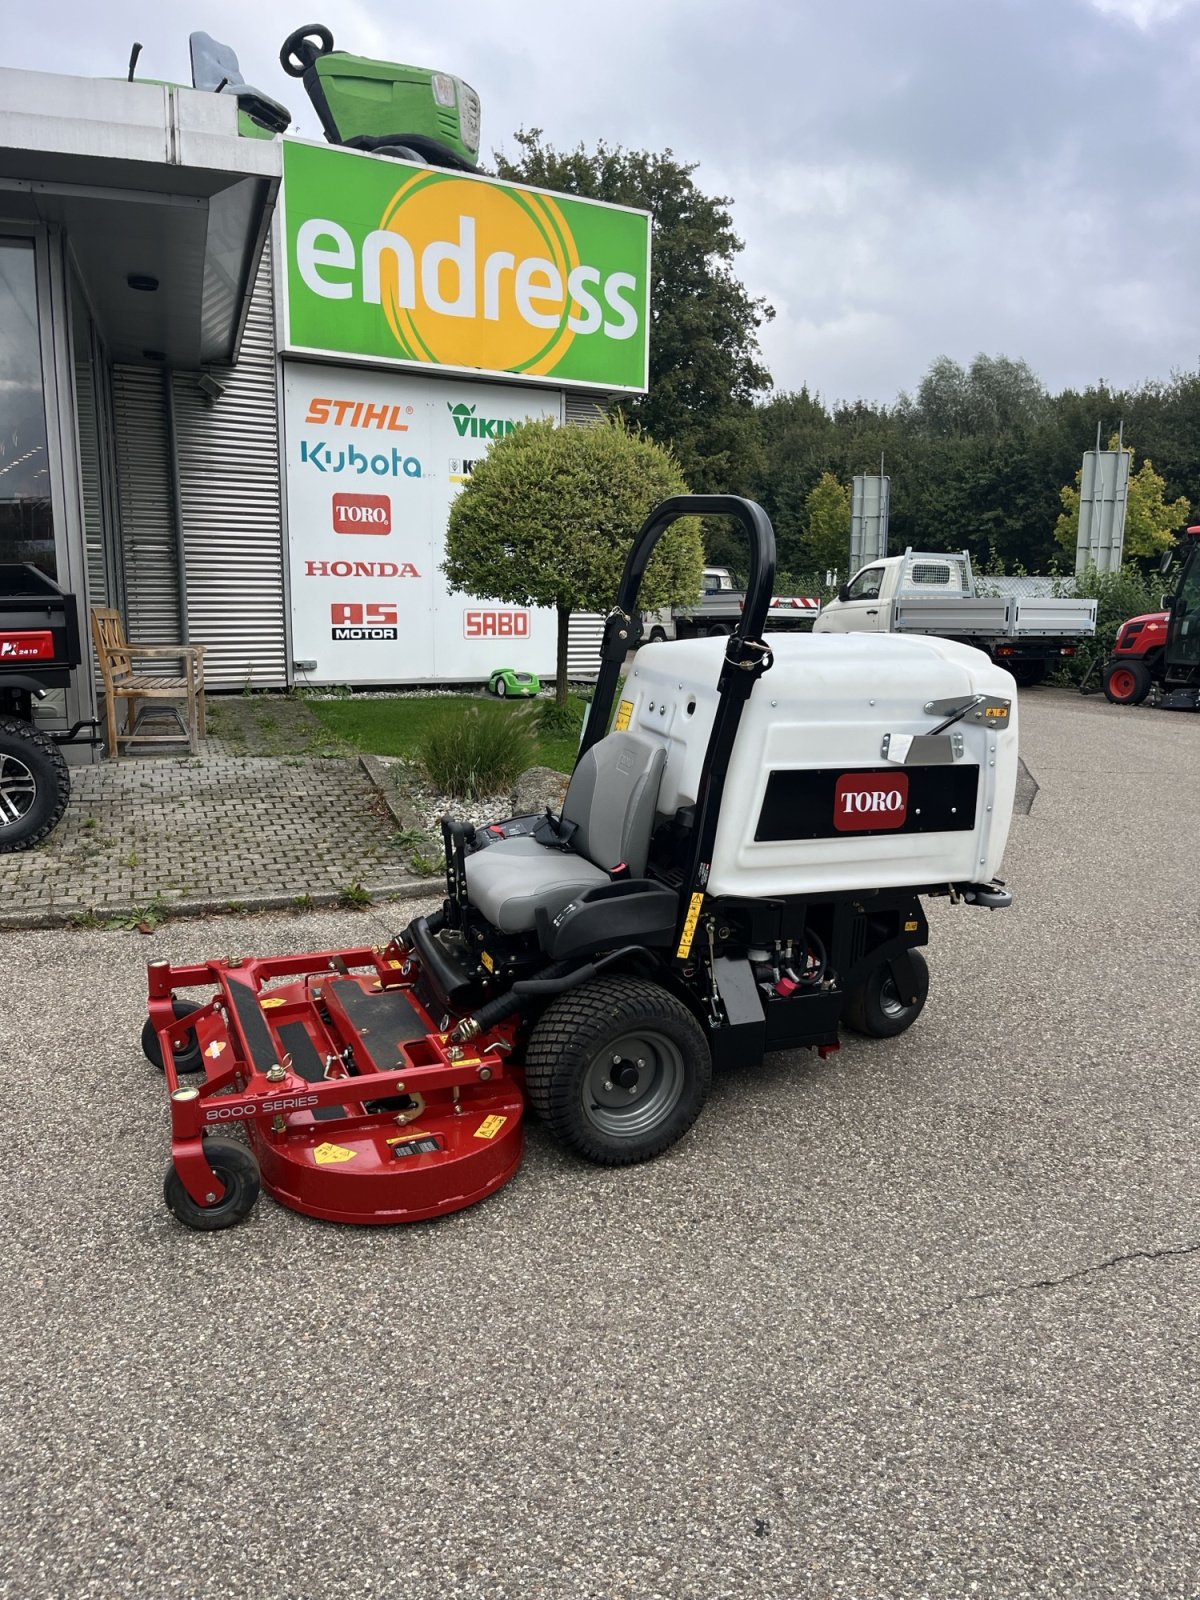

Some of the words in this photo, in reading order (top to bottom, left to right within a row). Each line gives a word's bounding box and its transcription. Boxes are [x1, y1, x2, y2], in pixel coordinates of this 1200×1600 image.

[296, 215, 638, 340] endress
[305, 398, 409, 431] STIHL
[301, 440, 421, 478] Kubota
[336, 505, 388, 524] TORO
[304, 561, 421, 578] HONDA
[331, 603, 397, 625] AS
[466, 612, 527, 636] SABO
[335, 628, 395, 640] MOTOR
[841, 790, 904, 813] TORO
[206, 1104, 257, 1120] 8000
[262, 1095, 319, 1113] SERIES
